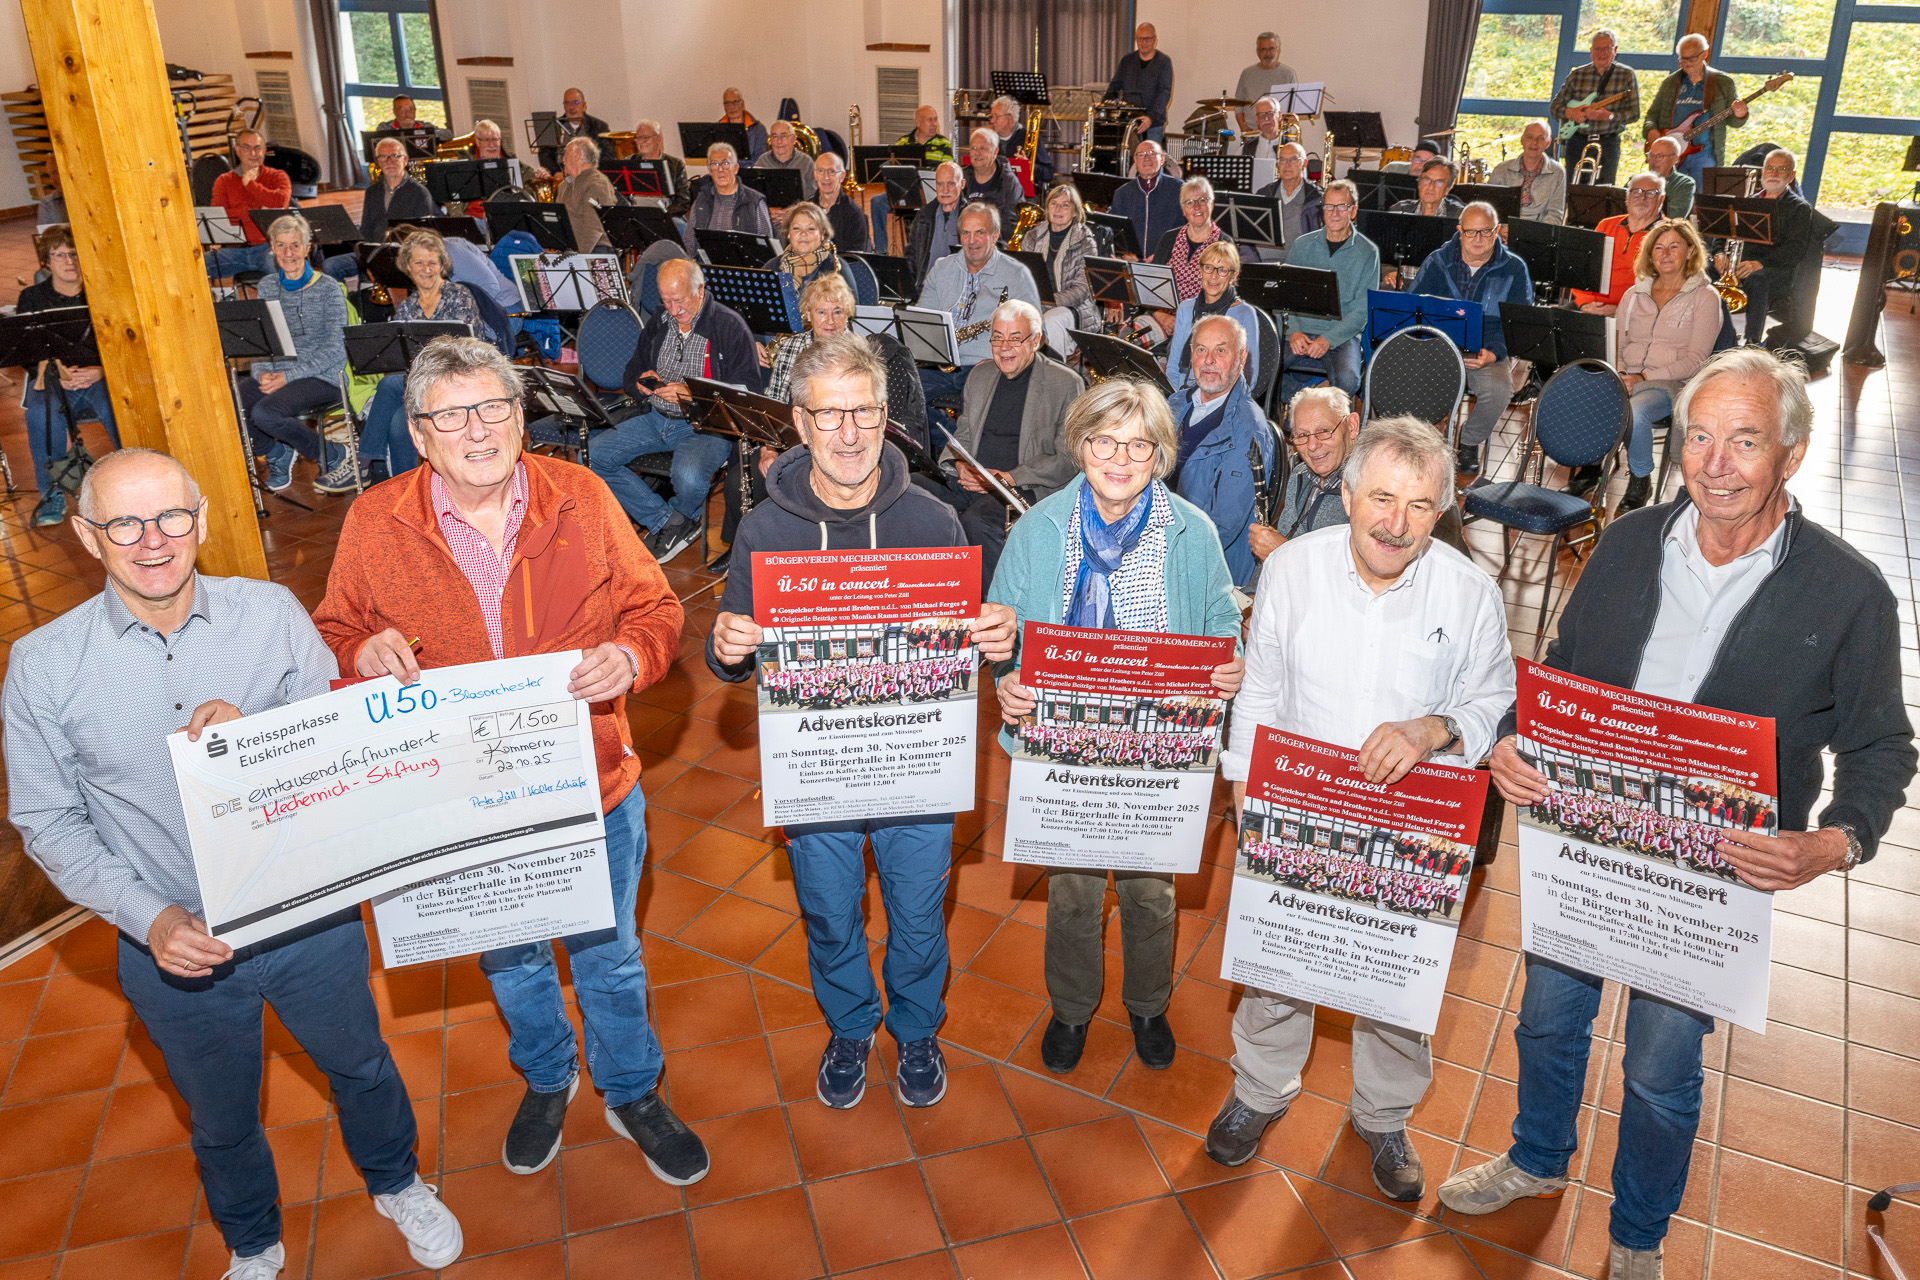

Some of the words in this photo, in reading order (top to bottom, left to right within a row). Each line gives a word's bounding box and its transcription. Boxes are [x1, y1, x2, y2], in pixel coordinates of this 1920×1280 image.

[765, 556, 838, 565] BÜRGERVEREIN
[840, 552, 953, 562] MECHERNICH-KOMMERN
[850, 564, 888, 573] präsentiert
[777, 575, 818, 592] Ü-50
[821, 579, 836, 591] in
[839, 577, 890, 590] concert
[1036, 626, 1104, 640] BÜRGERVEREIN
[1105, 634, 1211, 647] MECHERNICH-KOMMERN
[1044, 644, 1082, 662] Ü-50
[1084, 652, 1098, 663] in
[1101, 656, 1148, 667] concert
[1528, 665, 1599, 695] BÜRGERVEREIN
[1601, 688, 1736, 725] MECHERNICH-KOMMERN
[1738, 720, 1760, 730] e.V.
[474, 720, 490, 736] €
[509, 710, 558, 731] 1.500
[798, 708, 942, 733] Adventskonzert
[1537, 690, 1577, 716] Ü-50
[1580, 708, 1597, 723] in
[1600, 716, 1659, 736] concert
[1612, 704, 1655, 718] präsentiert
[236, 712, 339, 750] Kreissparkasse
[239, 737, 315, 768] Euskirchen
[483, 740, 555, 765] Kommern
[791, 749, 838, 757] Sonntag,
[841, 746, 863, 754] dem
[866, 744, 882, 752] 30.
[886, 740, 939, 750] November
[942, 735, 966, 746] 2025
[1268, 733, 1339, 757] BÜRGERVEREIN
[1460, 774, 1477, 783] e.V.
[248, 730, 440, 802] eintausendfünfhundert
[788, 761, 798, 770] in
[800, 760, 817, 769] der
[820, 755, 883, 768] Bürgerhalle
[900, 751, 951, 761] Kommern
[1045, 768, 1180, 790] Adventskonzert
[1275, 754, 1315, 777] Ü-50
[1317, 769, 1332, 782] in
[1335, 777, 1387, 794] concert
[212, 798, 242, 818] DE
[248, 804, 267, 812] Betrag
[1036, 796, 1079, 808] Sonntag,
[1124, 802, 1174, 811] November
[1176, 804, 1200, 812] 2025
[1043, 807, 1058, 815] der
[1061, 809, 1119, 820] Bürgerhalle
[1135, 813, 1184, 822] Kommern
[252, 822, 265, 830] oder
[456, 871, 484, 881] dem
[487, 865, 504, 876] 30.
[507, 855, 566, 872] November
[570, 848, 596, 861] 2025
[1558, 842, 1728, 906] Adventskonzert
[402, 894, 413, 903] in
[416, 891, 434, 901] der
[437, 878, 506, 897] Bürgerhalle
[510, 876, 521, 884] in
[524, 866, 582, 882] Kommern
[456, 895, 481, 903] Kaffee
[493, 888, 522, 896] Kuchen
[535, 880, 555, 889] 16:00
[418, 904, 474, 918] Konzertbeginn
[477, 899, 497, 908] 17:00
[536, 885, 573, 897] Platzwahl
[469, 908, 497, 917] Eintritt
[500, 903, 519, 912] 12,00
[1268, 890, 1418, 938] Adventskonzert
[1531, 871, 1548, 881] am
[1551, 874, 1602, 898] Sonntag,
[1605, 891, 1631, 906] dem
[1635, 899, 1653, 912] 30.
[1657, 905, 1724, 933] November
[1727, 926, 1759, 944] 2025
[1548, 886, 1558, 897] in
[1560, 891, 1578, 903] der
[1582, 897, 1654, 926] Bürgerhalle
[1657, 919, 1668, 931] in
[1673, 925, 1738, 953] Kommern
[1239, 914, 1255, 922] am
[1258, 917, 1304, 936] Sonntag,
[1307, 930, 1330, 941] dem
[1332, 935, 1348, 946] 30.
[1352, 940, 1410, 960] November
[1412, 955, 1439, 967] 2025
[1253, 927, 1262, 936] in
[1265, 930, 1281, 940] der
[1284, 935, 1348, 957] Bürgerhalle
[1350, 951, 1361, 961] in
[1365, 955, 1420, 976] Kommern
